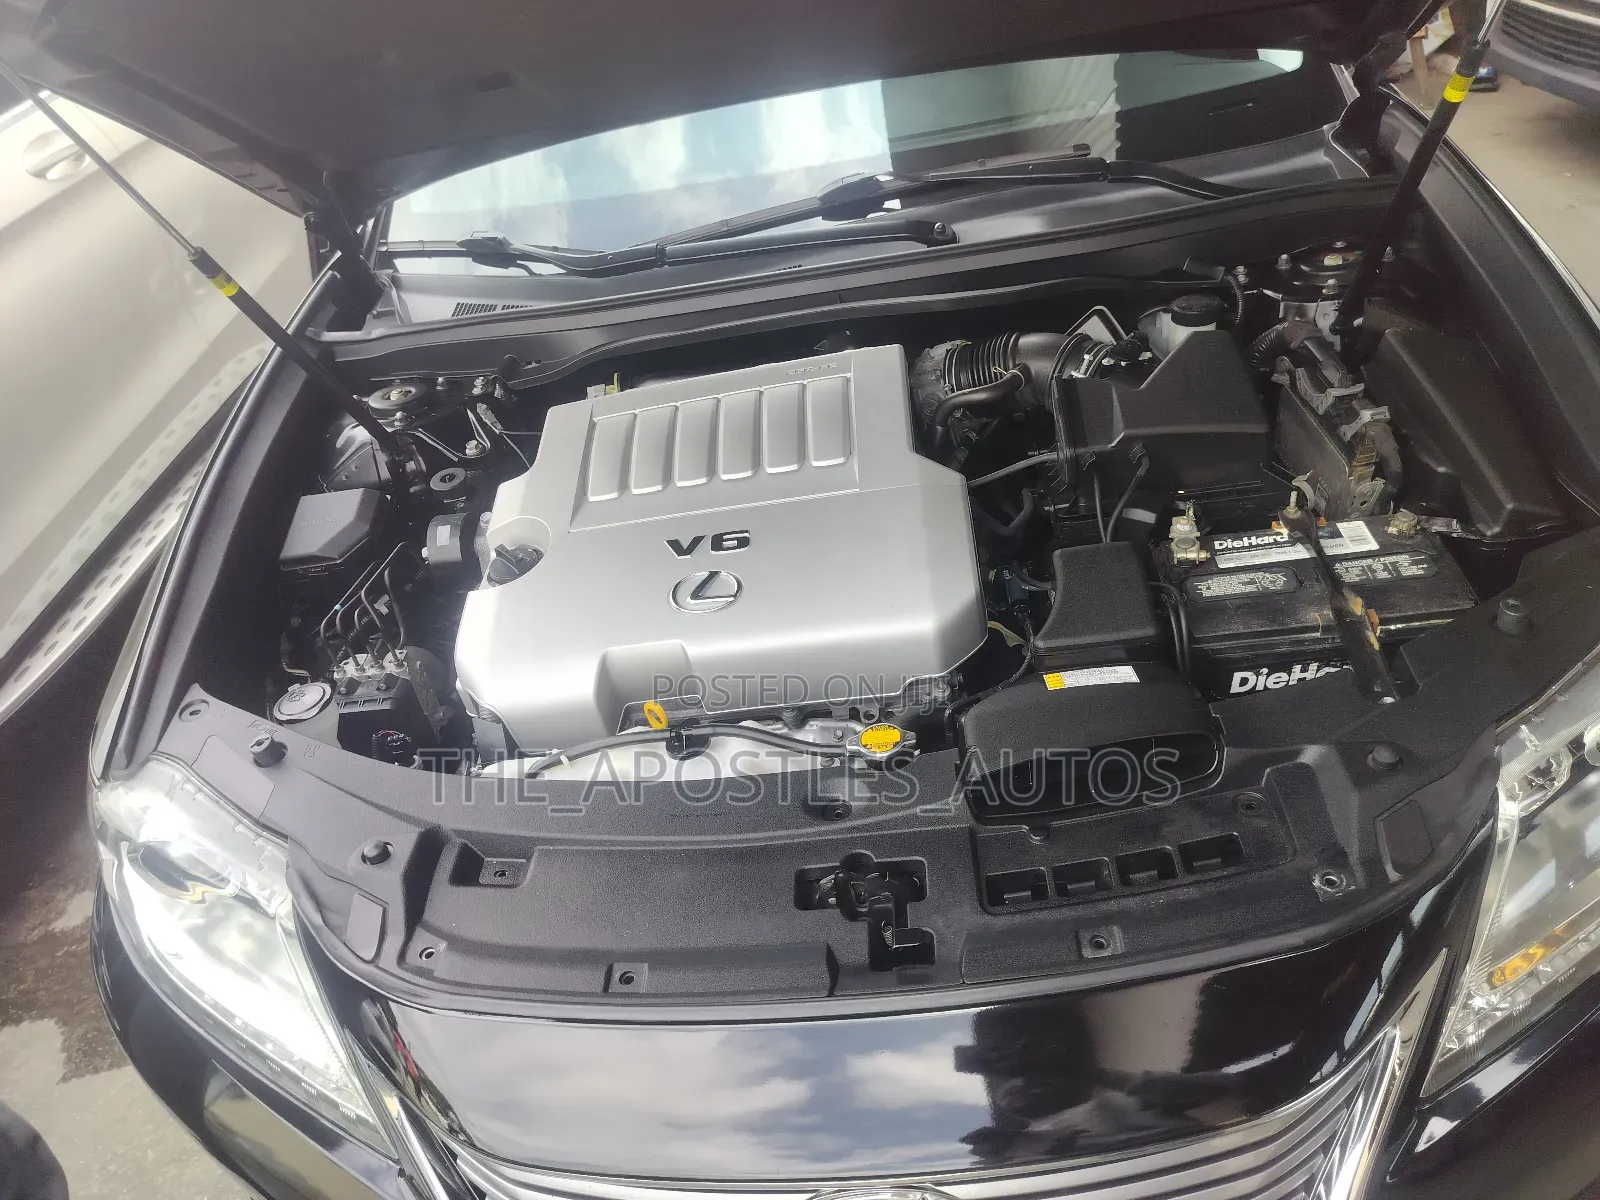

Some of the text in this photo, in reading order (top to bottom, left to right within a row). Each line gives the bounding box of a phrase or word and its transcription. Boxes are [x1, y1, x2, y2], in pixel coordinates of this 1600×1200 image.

[663, 529, 750, 559] V6
[1214, 531, 1289, 550] DieHard
[1229, 661, 1352, 694] DieH
